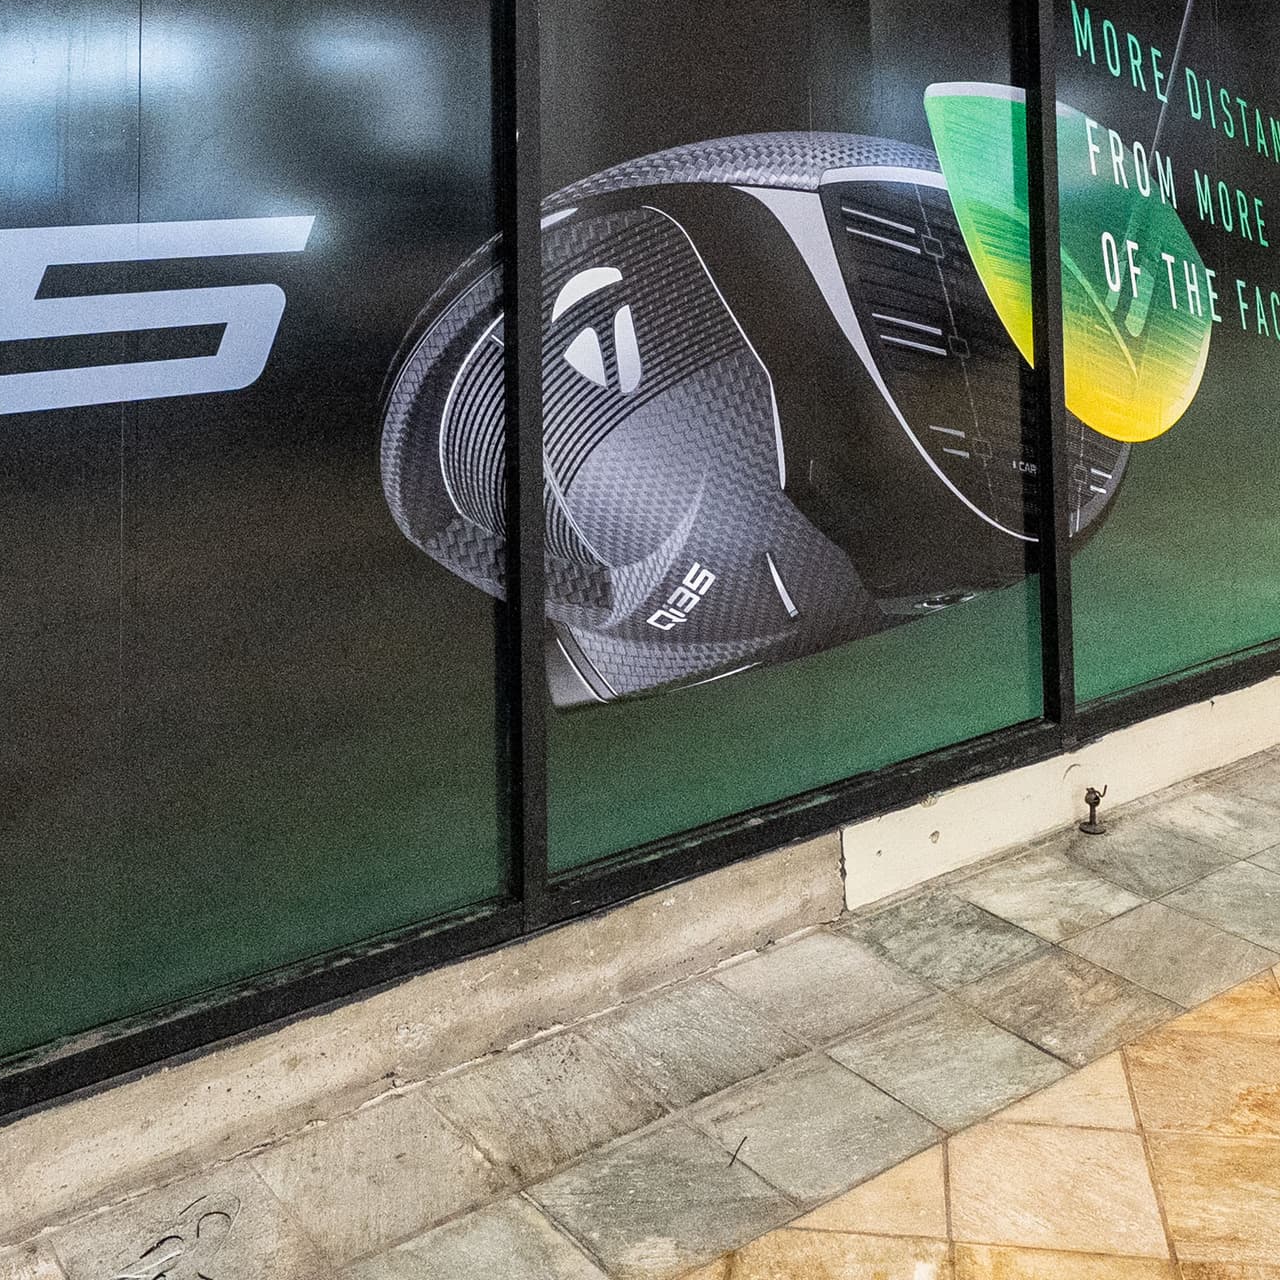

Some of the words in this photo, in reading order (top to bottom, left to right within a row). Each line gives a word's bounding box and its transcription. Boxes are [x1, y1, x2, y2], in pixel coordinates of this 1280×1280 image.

[1071, 0, 1168, 104] MORE
[1085, 118, 1177, 210] FROM
[1194, 170, 1269, 248] MORE
[1101, 231, 1141, 298] OF
[1161, 252, 1222, 323] THE
